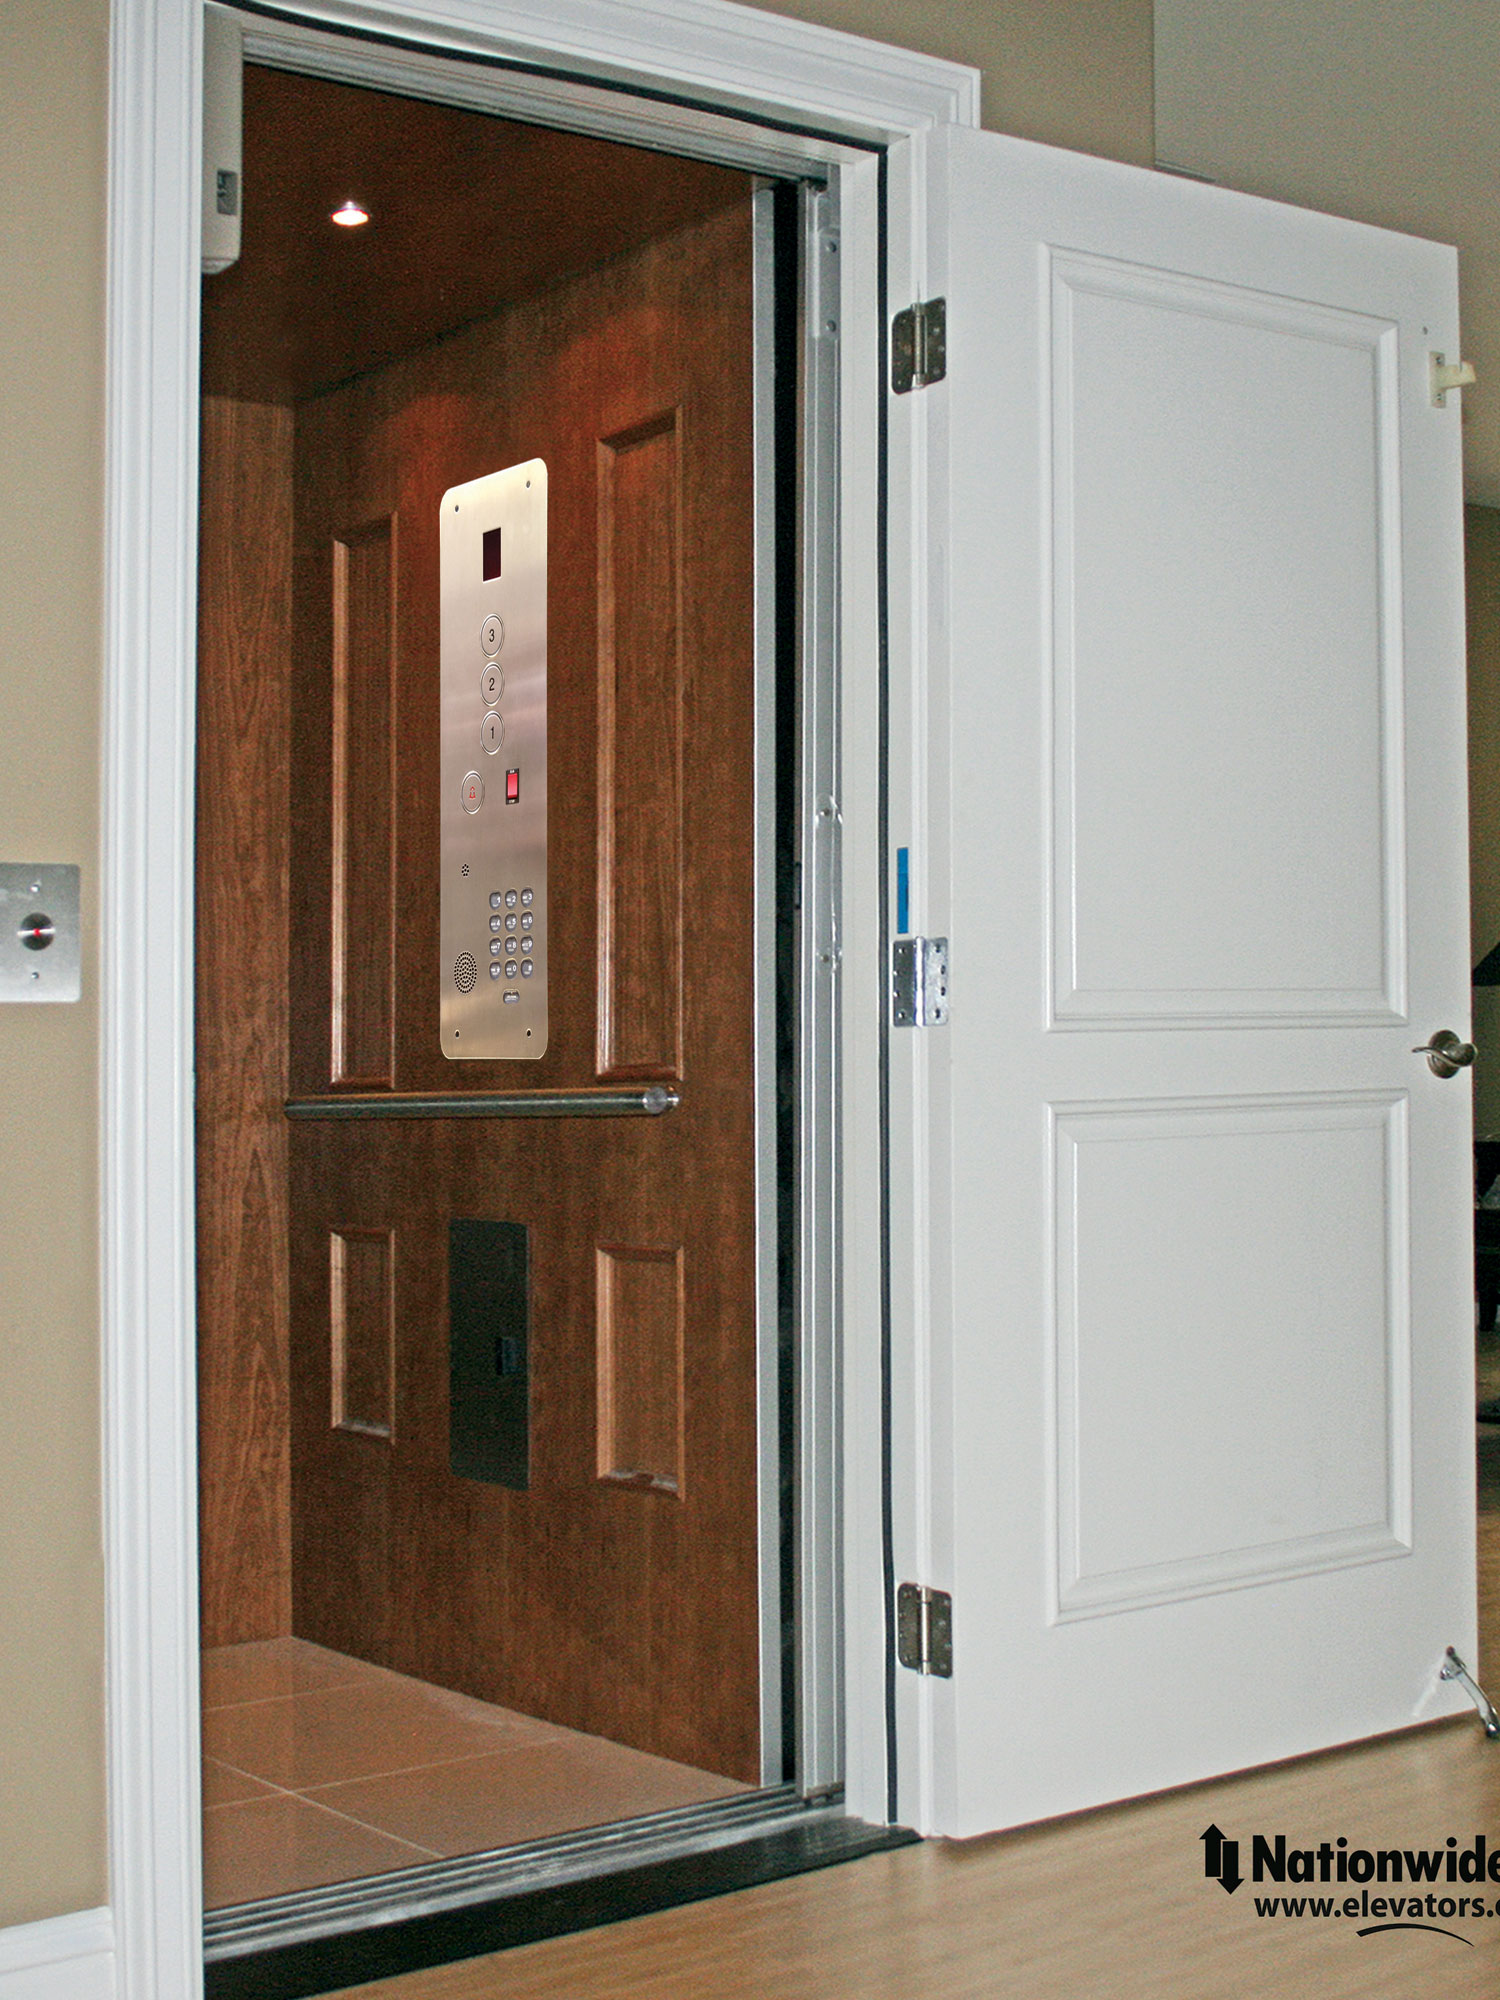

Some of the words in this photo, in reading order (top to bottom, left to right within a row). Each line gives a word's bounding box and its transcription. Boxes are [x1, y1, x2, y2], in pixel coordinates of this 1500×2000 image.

[488, 628, 495, 642] 3
[488, 677, 495, 691] 2
[490, 726, 495, 740] 1
